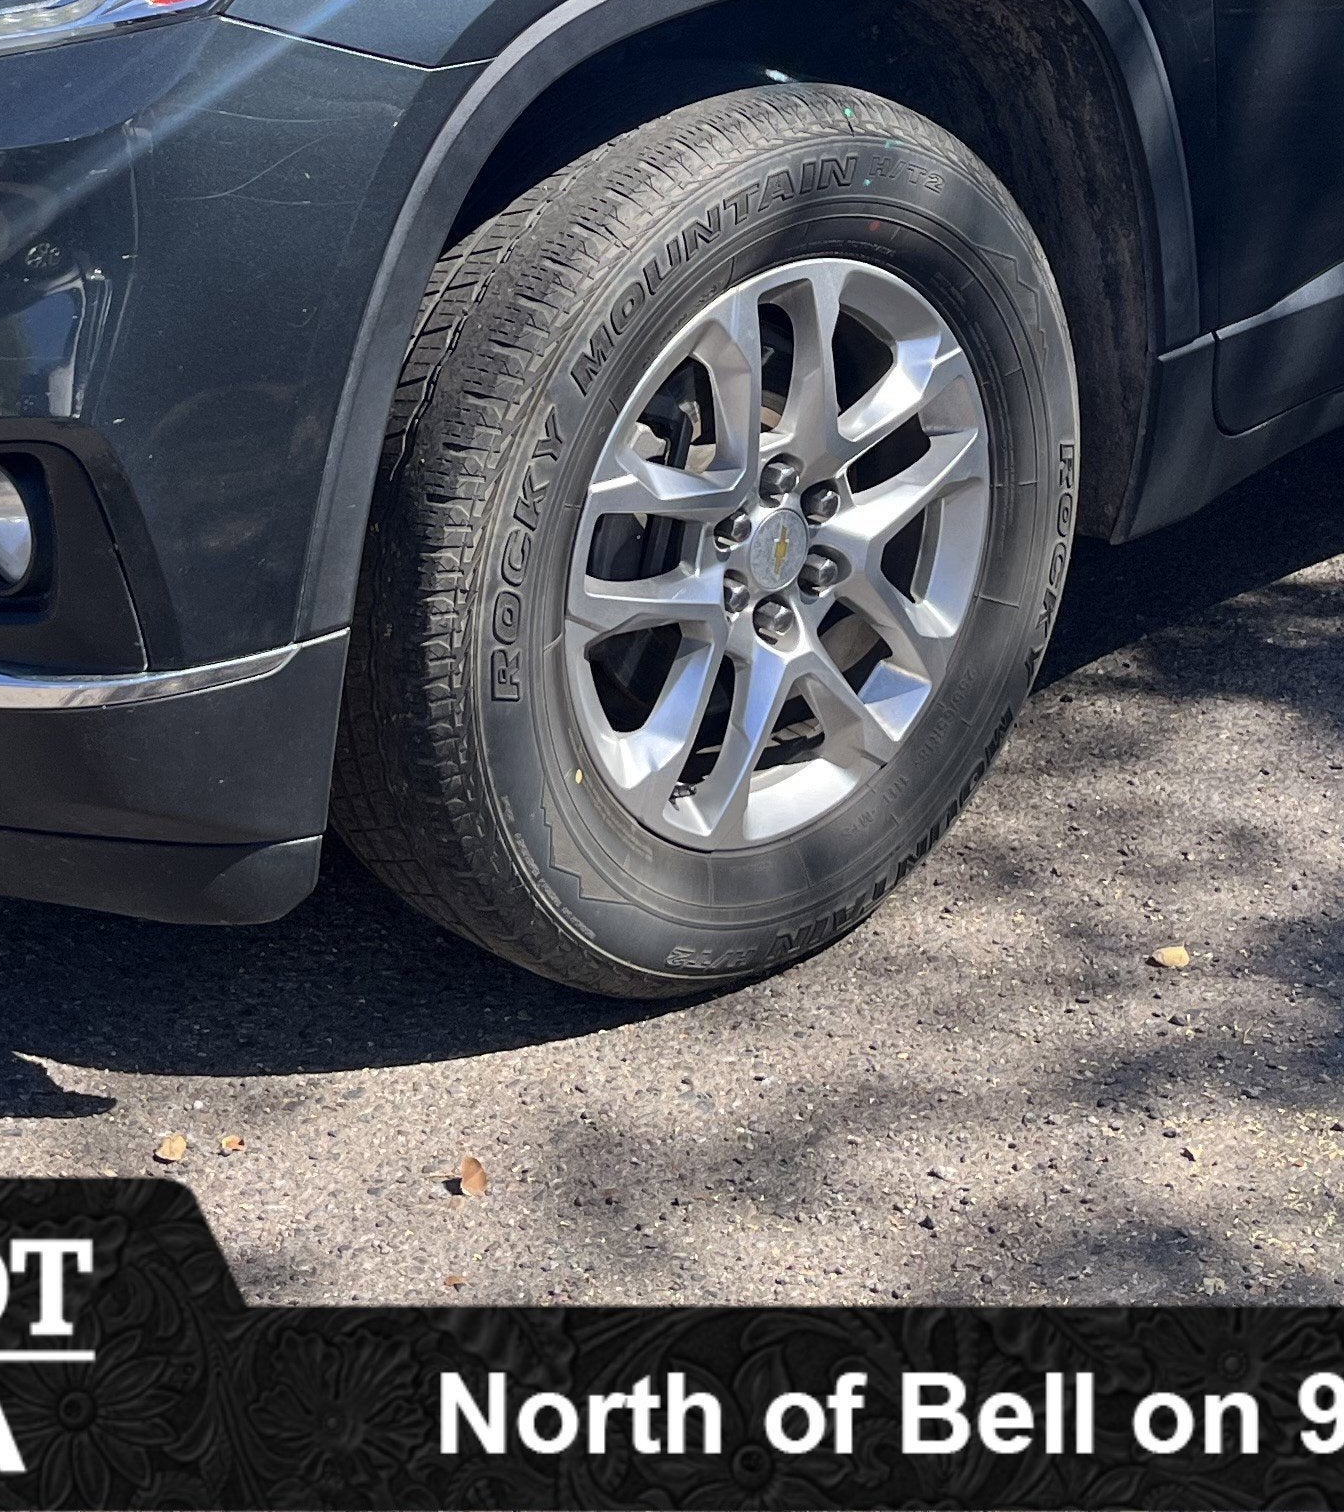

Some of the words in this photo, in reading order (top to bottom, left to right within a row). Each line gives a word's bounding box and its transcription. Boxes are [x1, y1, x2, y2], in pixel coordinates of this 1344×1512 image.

[488, 406, 566, 704] ROCKY
[574, 154, 862, 399] MOUNTAIN
[869, 154, 947, 195] H/T2
[1023, 439, 1076, 688] ROCKY
